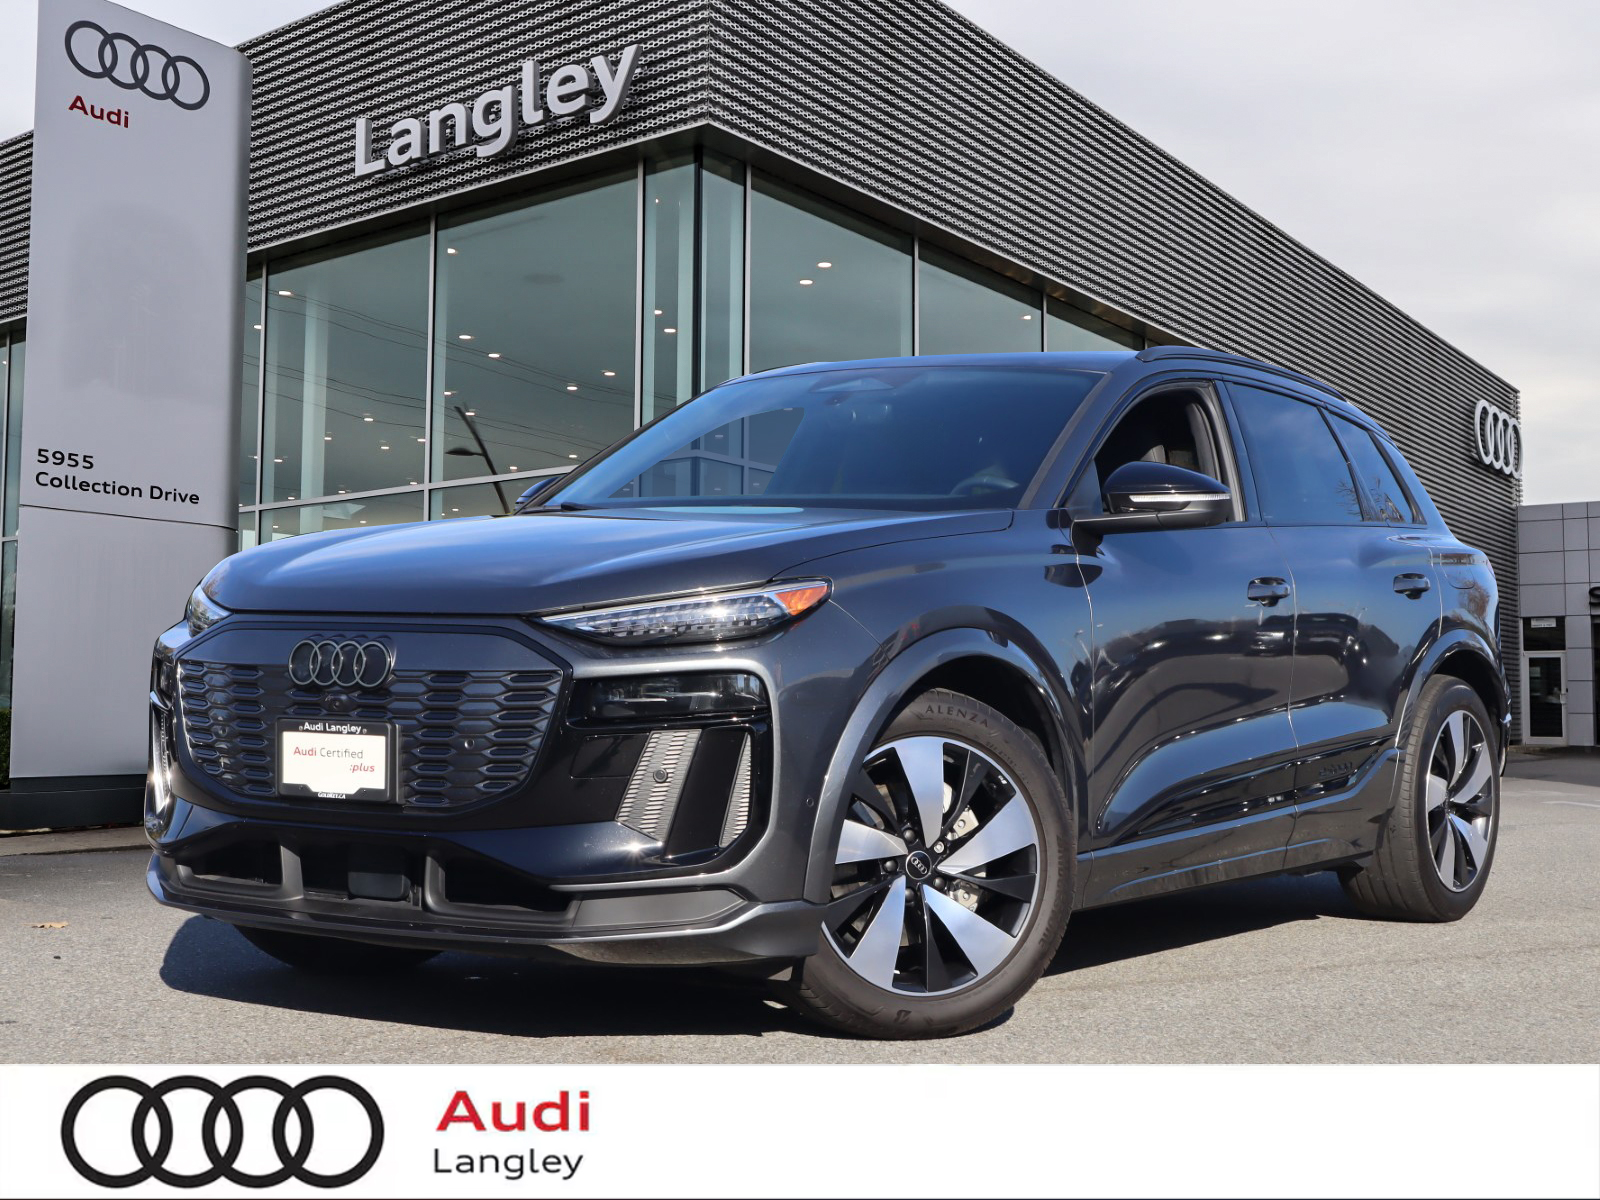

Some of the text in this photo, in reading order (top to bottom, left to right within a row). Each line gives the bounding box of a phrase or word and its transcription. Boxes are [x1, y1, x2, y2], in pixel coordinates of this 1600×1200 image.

[69, 95, 129, 129] Audi
[355, 44, 643, 177] Langley
[37, 448, 94, 470] 5955
[35, 471, 200, 505] Collection Drive
[925, 704, 989, 728] ALENZA
[303, 722, 362, 735] Audi Langley
[293, 746, 364, 759] Audi Certified
[349, 762, 375, 774] :plus
